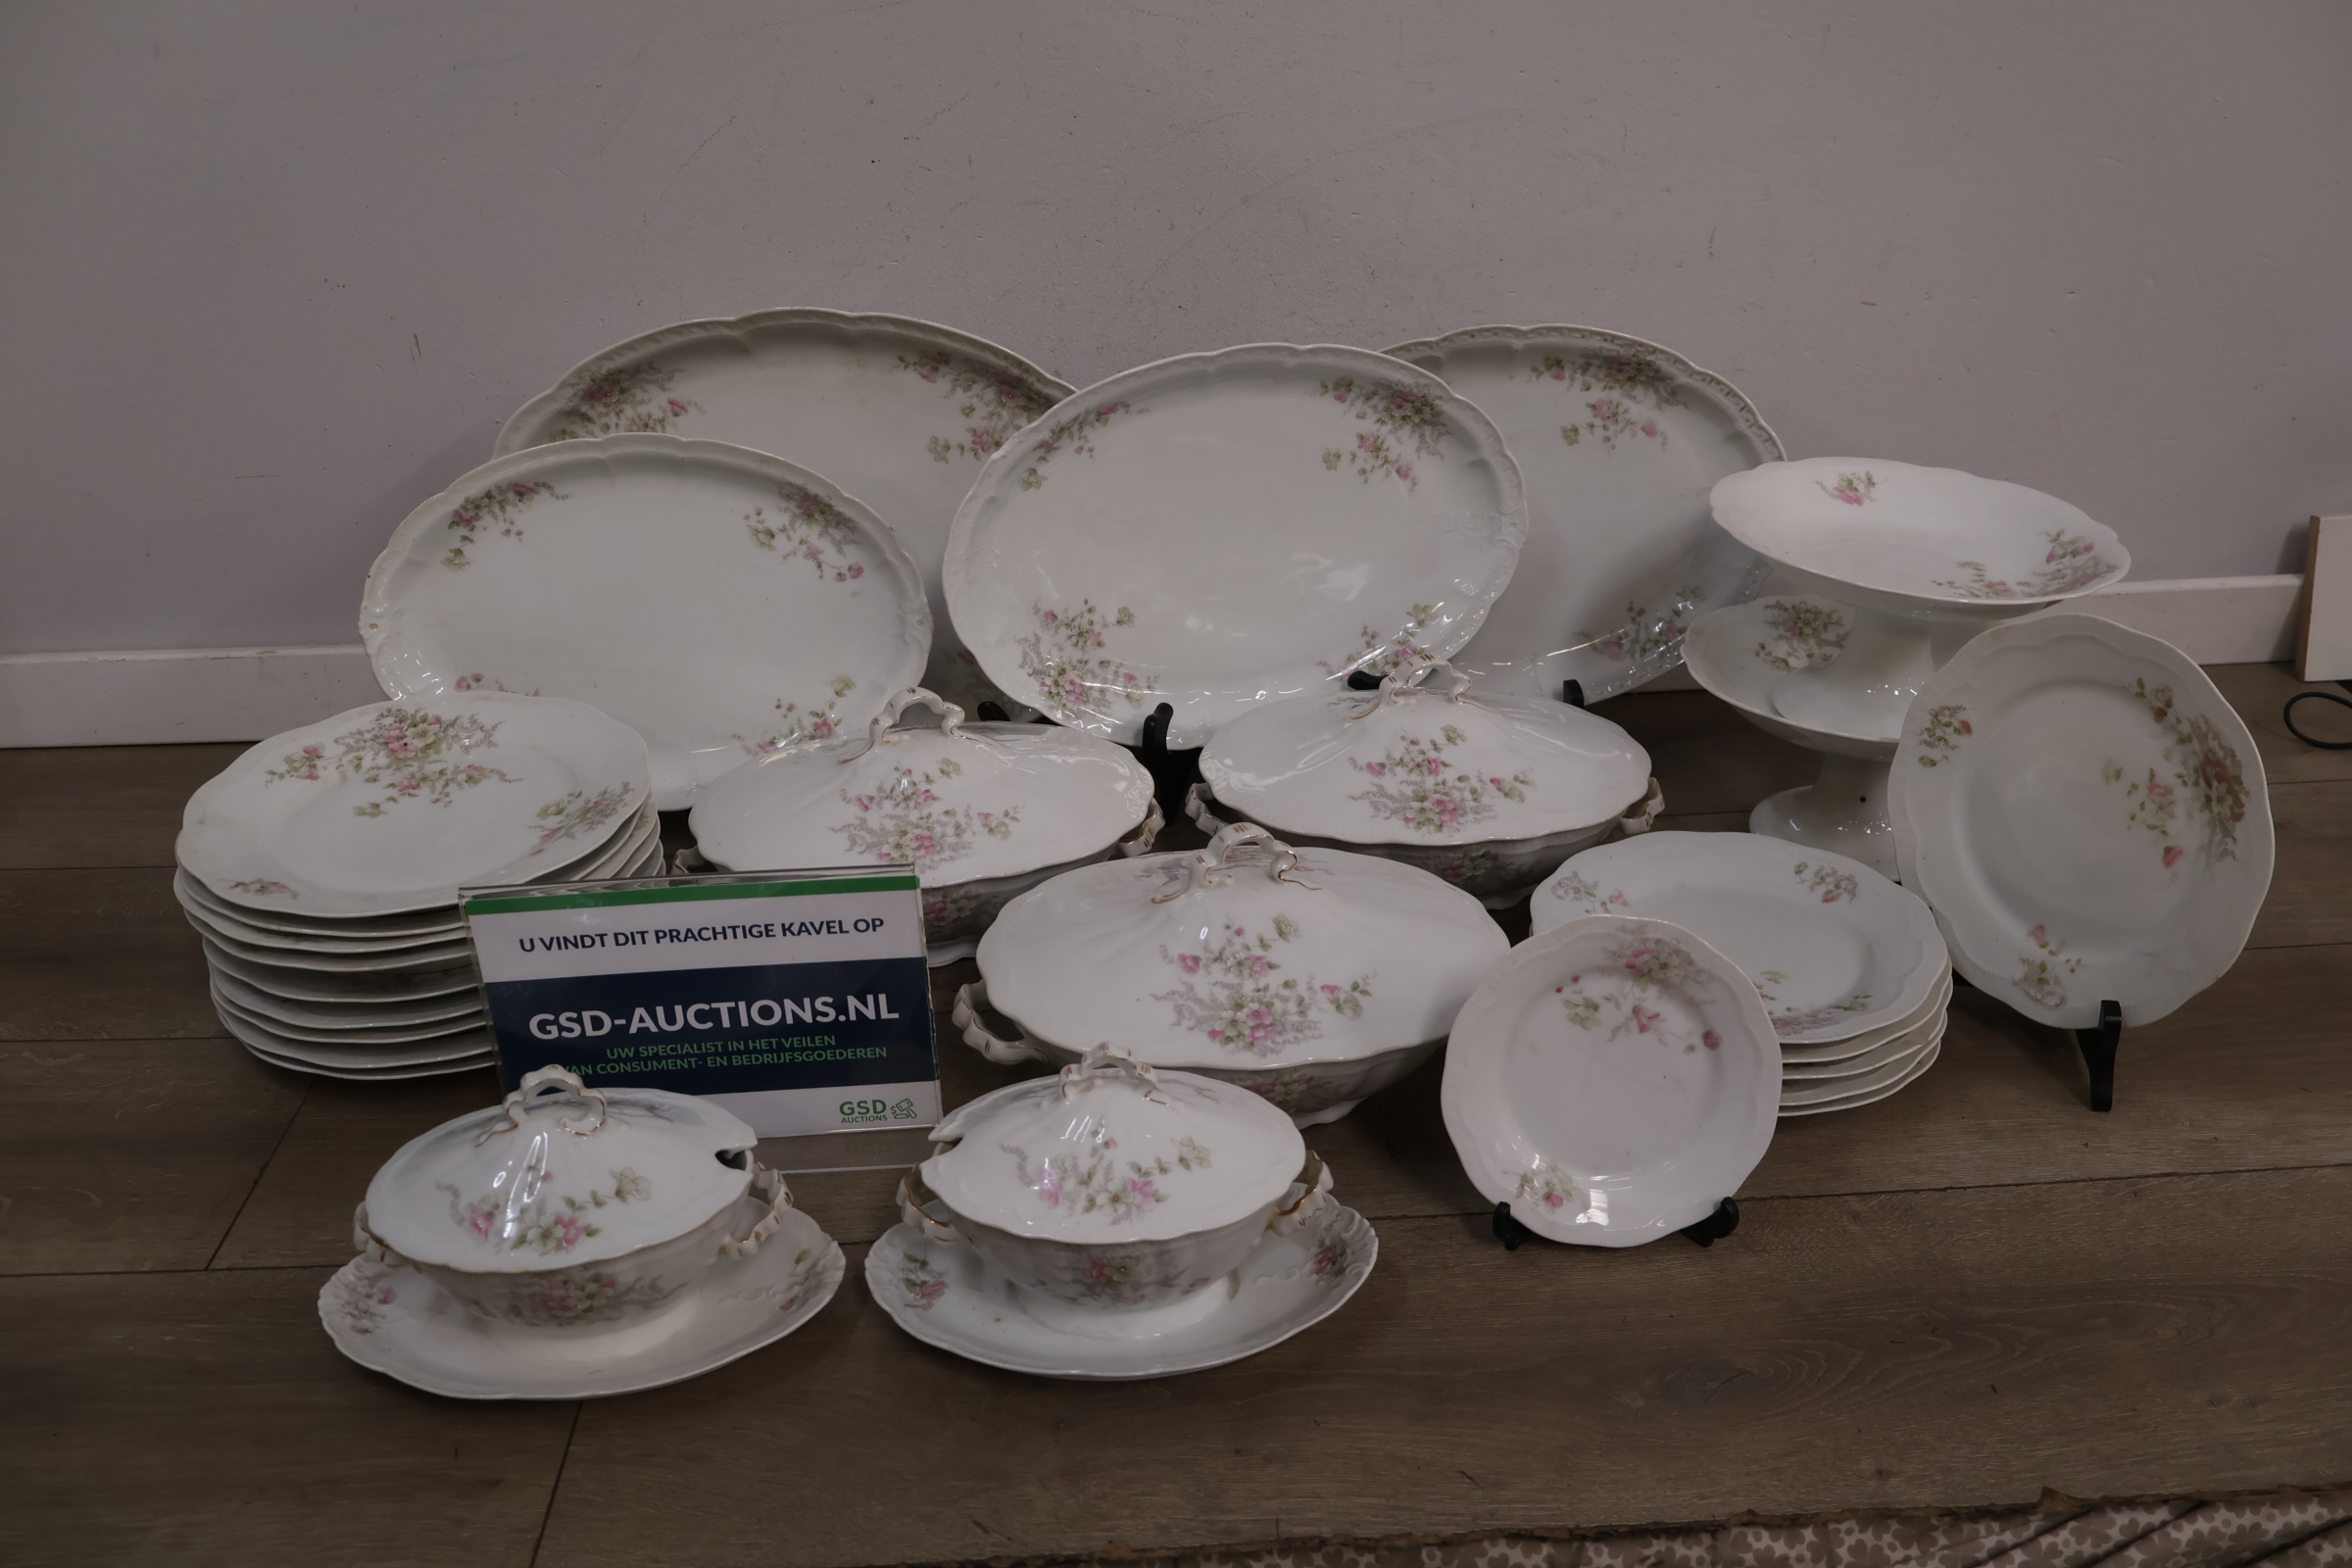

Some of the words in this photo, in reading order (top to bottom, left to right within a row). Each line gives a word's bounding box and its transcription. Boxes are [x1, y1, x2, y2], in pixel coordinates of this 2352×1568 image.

[519, 938, 536, 953] U
[539, 933, 609, 952] VINDT
[612, 930, 650, 947] DIT
[654, 923, 777, 944] PRACHTIGE
[781, 919, 850, 937] KAVEL
[853, 917, 884, 933] OP
[528, 993, 900, 1040] GSD-AUCTIONS.NL
[606, 1047, 635, 1059] UW
[638, 1041, 724, 1057] SPECIALIST
[727, 1039, 745, 1052] IN
[748, 1038, 779, 1051] HET
[781, 1035, 836, 1048] VEILEN
[564, 1064, 593, 1076] AN
[596, 1056, 703, 1074] CONSUMENT-
[707, 1055, 728, 1068] EN
[731, 1047, 888, 1066] BEDRIJFSGOEDEREN
[839, 1100, 887, 1116] GSD
[841, 1114, 888, 1124] AUCTIONS
